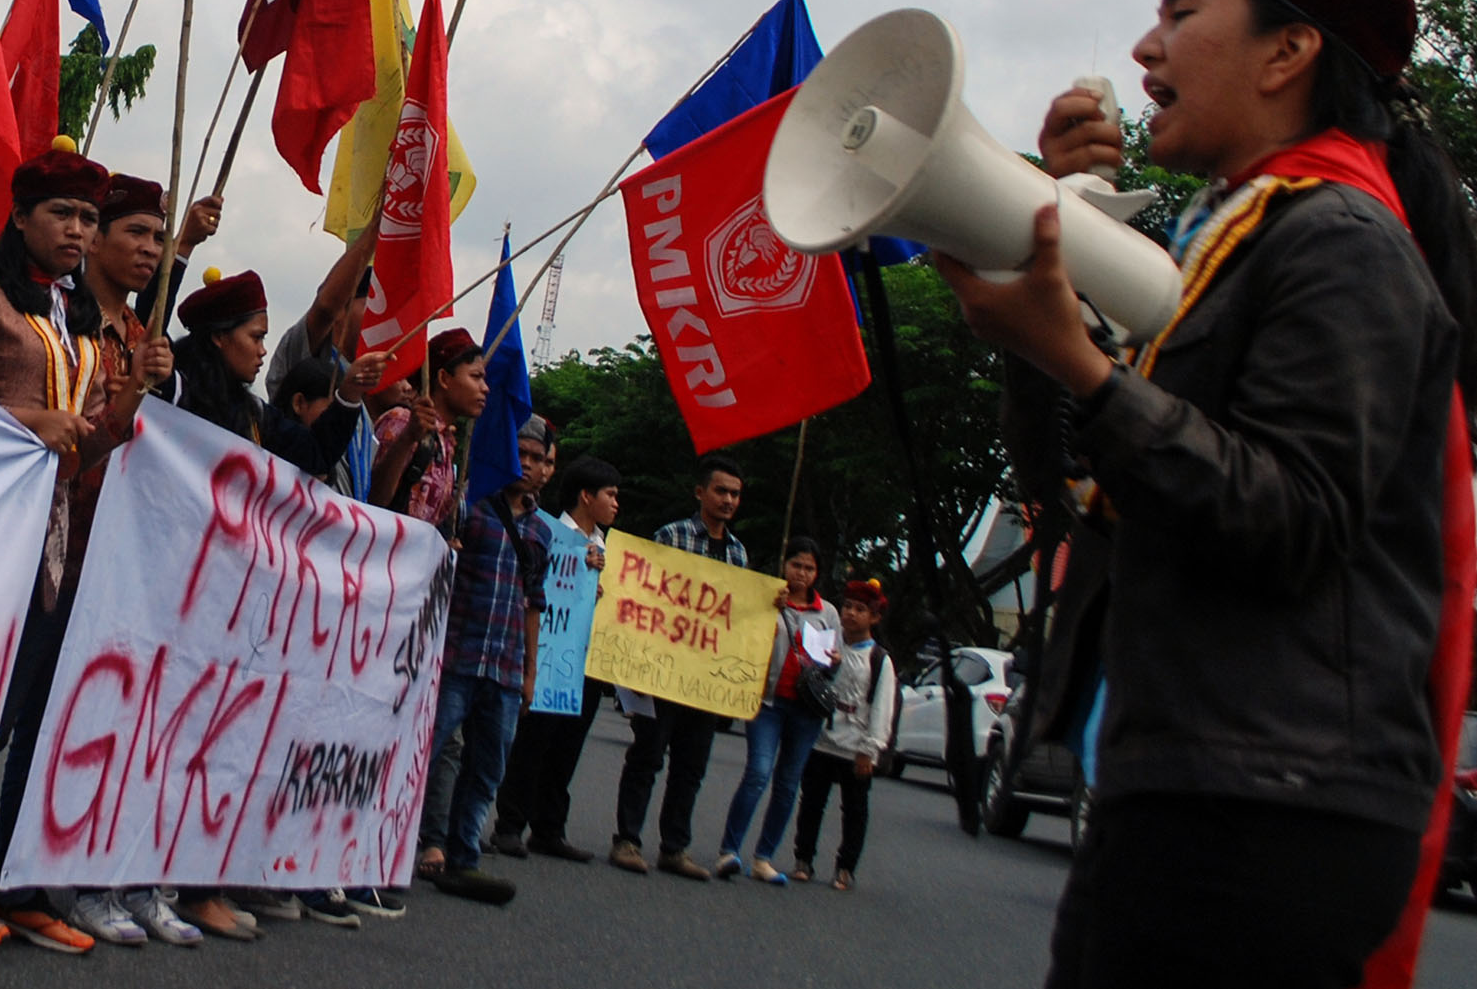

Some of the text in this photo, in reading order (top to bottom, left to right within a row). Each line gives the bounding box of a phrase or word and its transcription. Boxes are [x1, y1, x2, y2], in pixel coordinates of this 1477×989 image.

[642, 173, 737, 408] PMKRI
[180, 453, 406, 680] PMKRI
[617, 598, 719, 654] BERSIH
[619, 550, 733, 631] PILKADA
[43, 645, 289, 878] GMKI
